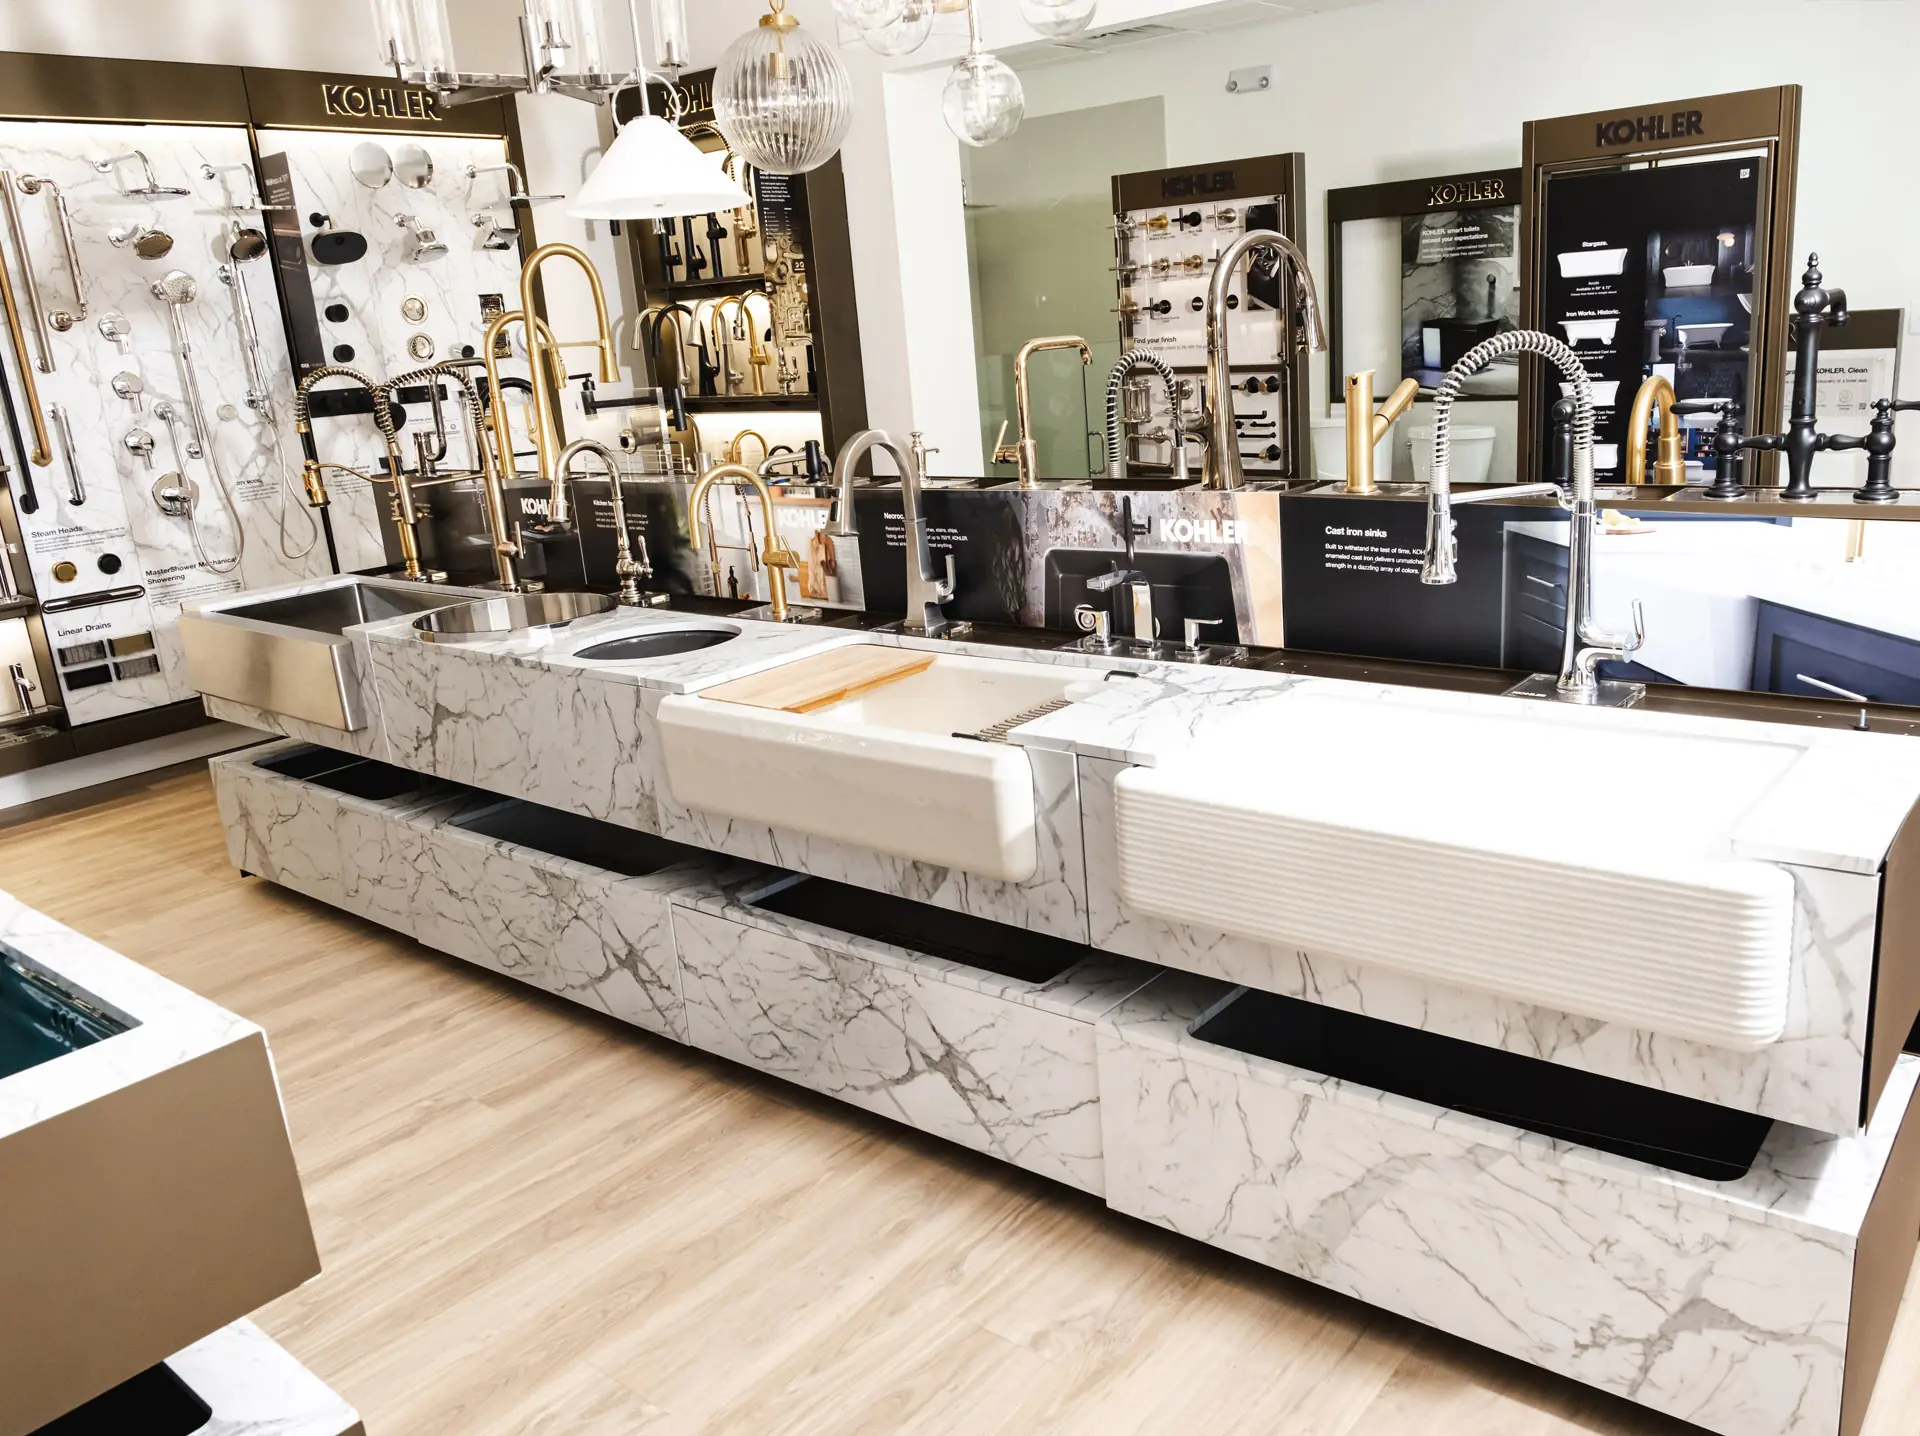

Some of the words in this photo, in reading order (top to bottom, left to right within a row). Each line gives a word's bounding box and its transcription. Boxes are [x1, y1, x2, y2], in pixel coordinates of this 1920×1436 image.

[322, 84, 442, 121] KOHLER
[661, 81, 716, 119] KOHL
[1595, 110, 1704, 148] KOHLER
[1161, 171, 1237, 199] KOHLER
[1427, 178, 1505, 206] KOHLER
[1463, 225, 1480, 233] toilets
[1454, 233, 1489, 241] expectations
[1847, 366, 1868, 374] Clean
[520, 498, 548, 515] KOHL
[776, 507, 830, 530] KOHLE
[31, 530, 57, 539] Steam
[59, 526, 83, 535] Heads
[1160, 518, 1249, 544] KOHLER
[1325, 526, 1345, 535] Cast
[1346, 527, 1363, 536] iron
[1364, 528, 1387, 538] sinks
[145, 564, 197, 577] MasterShower
[1357, 564, 1379, 572] dazzling
[147, 573, 186, 585] Showering
[57, 627, 83, 637] Linear
[85, 622, 112, 631] Drains
